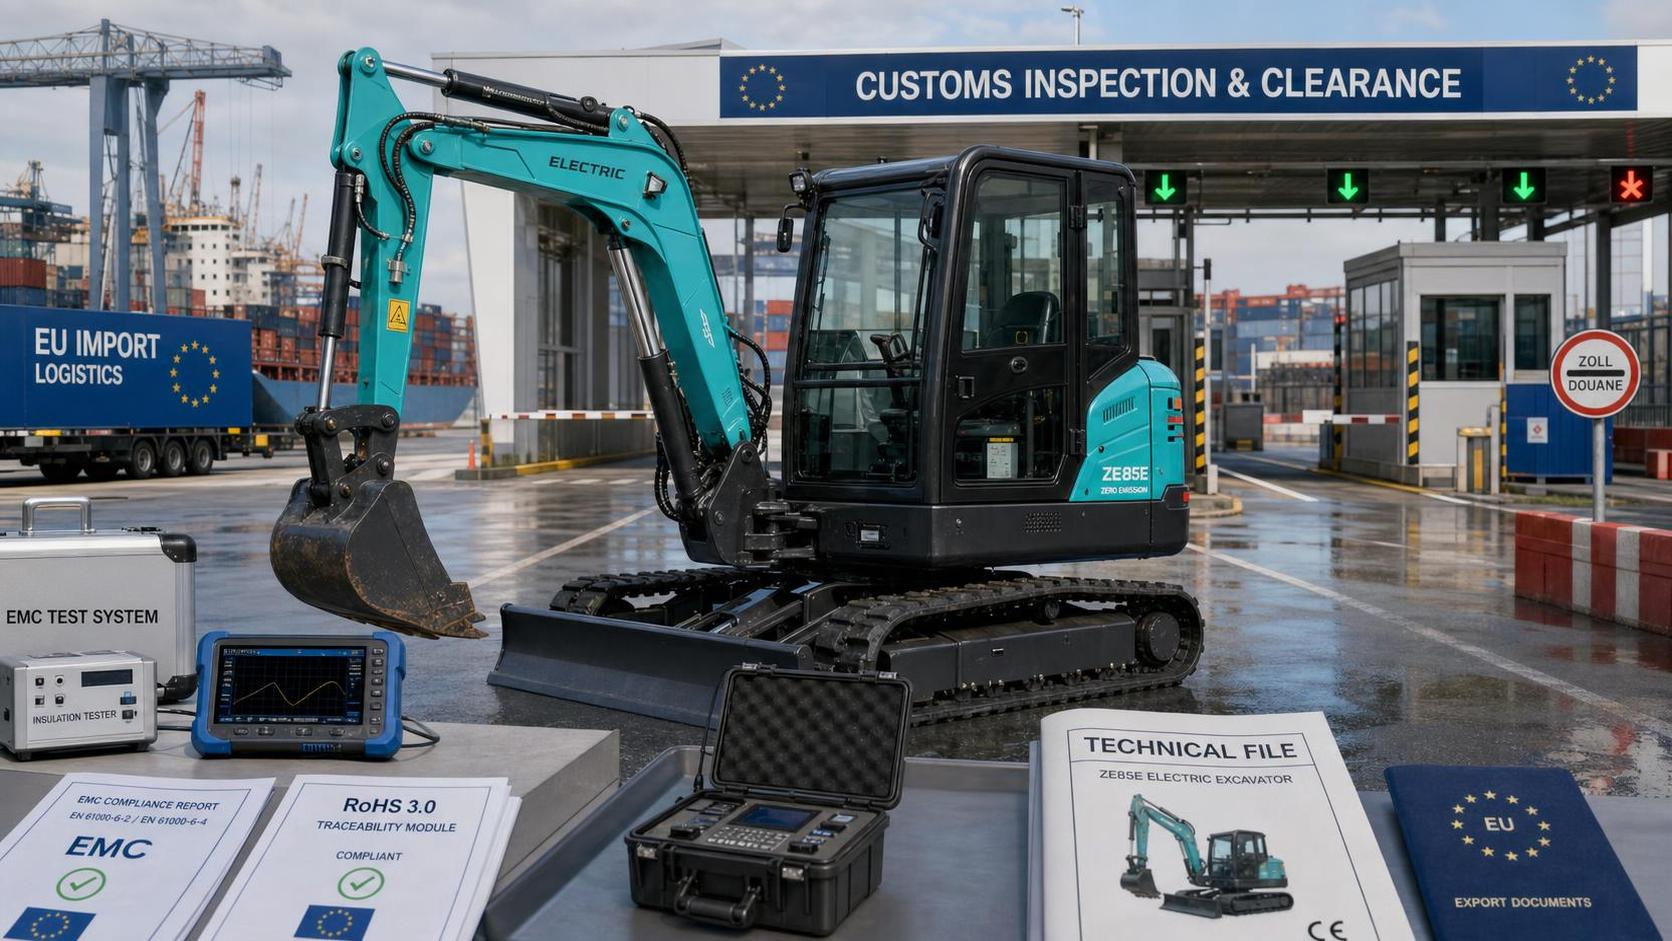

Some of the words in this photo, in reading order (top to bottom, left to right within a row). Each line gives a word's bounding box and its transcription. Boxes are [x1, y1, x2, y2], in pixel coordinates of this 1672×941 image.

[856, 69, 1012, 101] CUSTOMS
[1025, 67, 1217, 101] INSPECTION
[1227, 68, 1251, 99] &
[1261, 67, 1463, 99] CLEARANCE
[549, 156, 626, 180] ELECTRIC
[35, 327, 67, 357] EU
[76, 329, 161, 360] IMPORT
[1578, 356, 1613, 367] ZOLL
[35, 363, 123, 385] LOGISTICS
[1568, 380, 1623, 391] DOUANE
[1102, 466, 1149, 482] ZE85E
[1100, 487, 1118, 495] ZERO
[6, 609, 42, 624] EMC
[47, 609, 88, 624] TEST
[93, 609, 159, 624] SYSTEM
[32, 713, 81, 725] INSULATION
[83, 710, 117, 721] TESTER
[1083, 736, 1237, 759] TECHNICAL
[1243, 742, 1298, 759] FILE
[1147, 772, 1212, 784] ELECTRIC
[1216, 774, 1294, 785] EXCAVATOR
[77, 795, 103, 805] EMC
[103, 797, 174, 810] COMPLIANCE
[175, 801, 220, 811] REPORT
[343, 797, 403, 814] RoHS
[406, 800, 437, 814] 3.0
[69, 812, 84, 820] EN
[84, 813, 132, 823] 61000-6-2
[131, 815, 139, 824] /
[140, 815, 156, 824] EN
[157, 816, 208, 826] 61000-6-4
[316, 820, 403, 832] TRACEABILITY
[405, 822, 457, 833] MODULE
[1484, 817, 1515, 832] EU
[65, 835, 153, 859] EMC
[335, 851, 403, 861] COMPLIANT
[1454, 897, 1507, 908] EXPORT
[1511, 897, 1592, 908] DOCUMENTS
